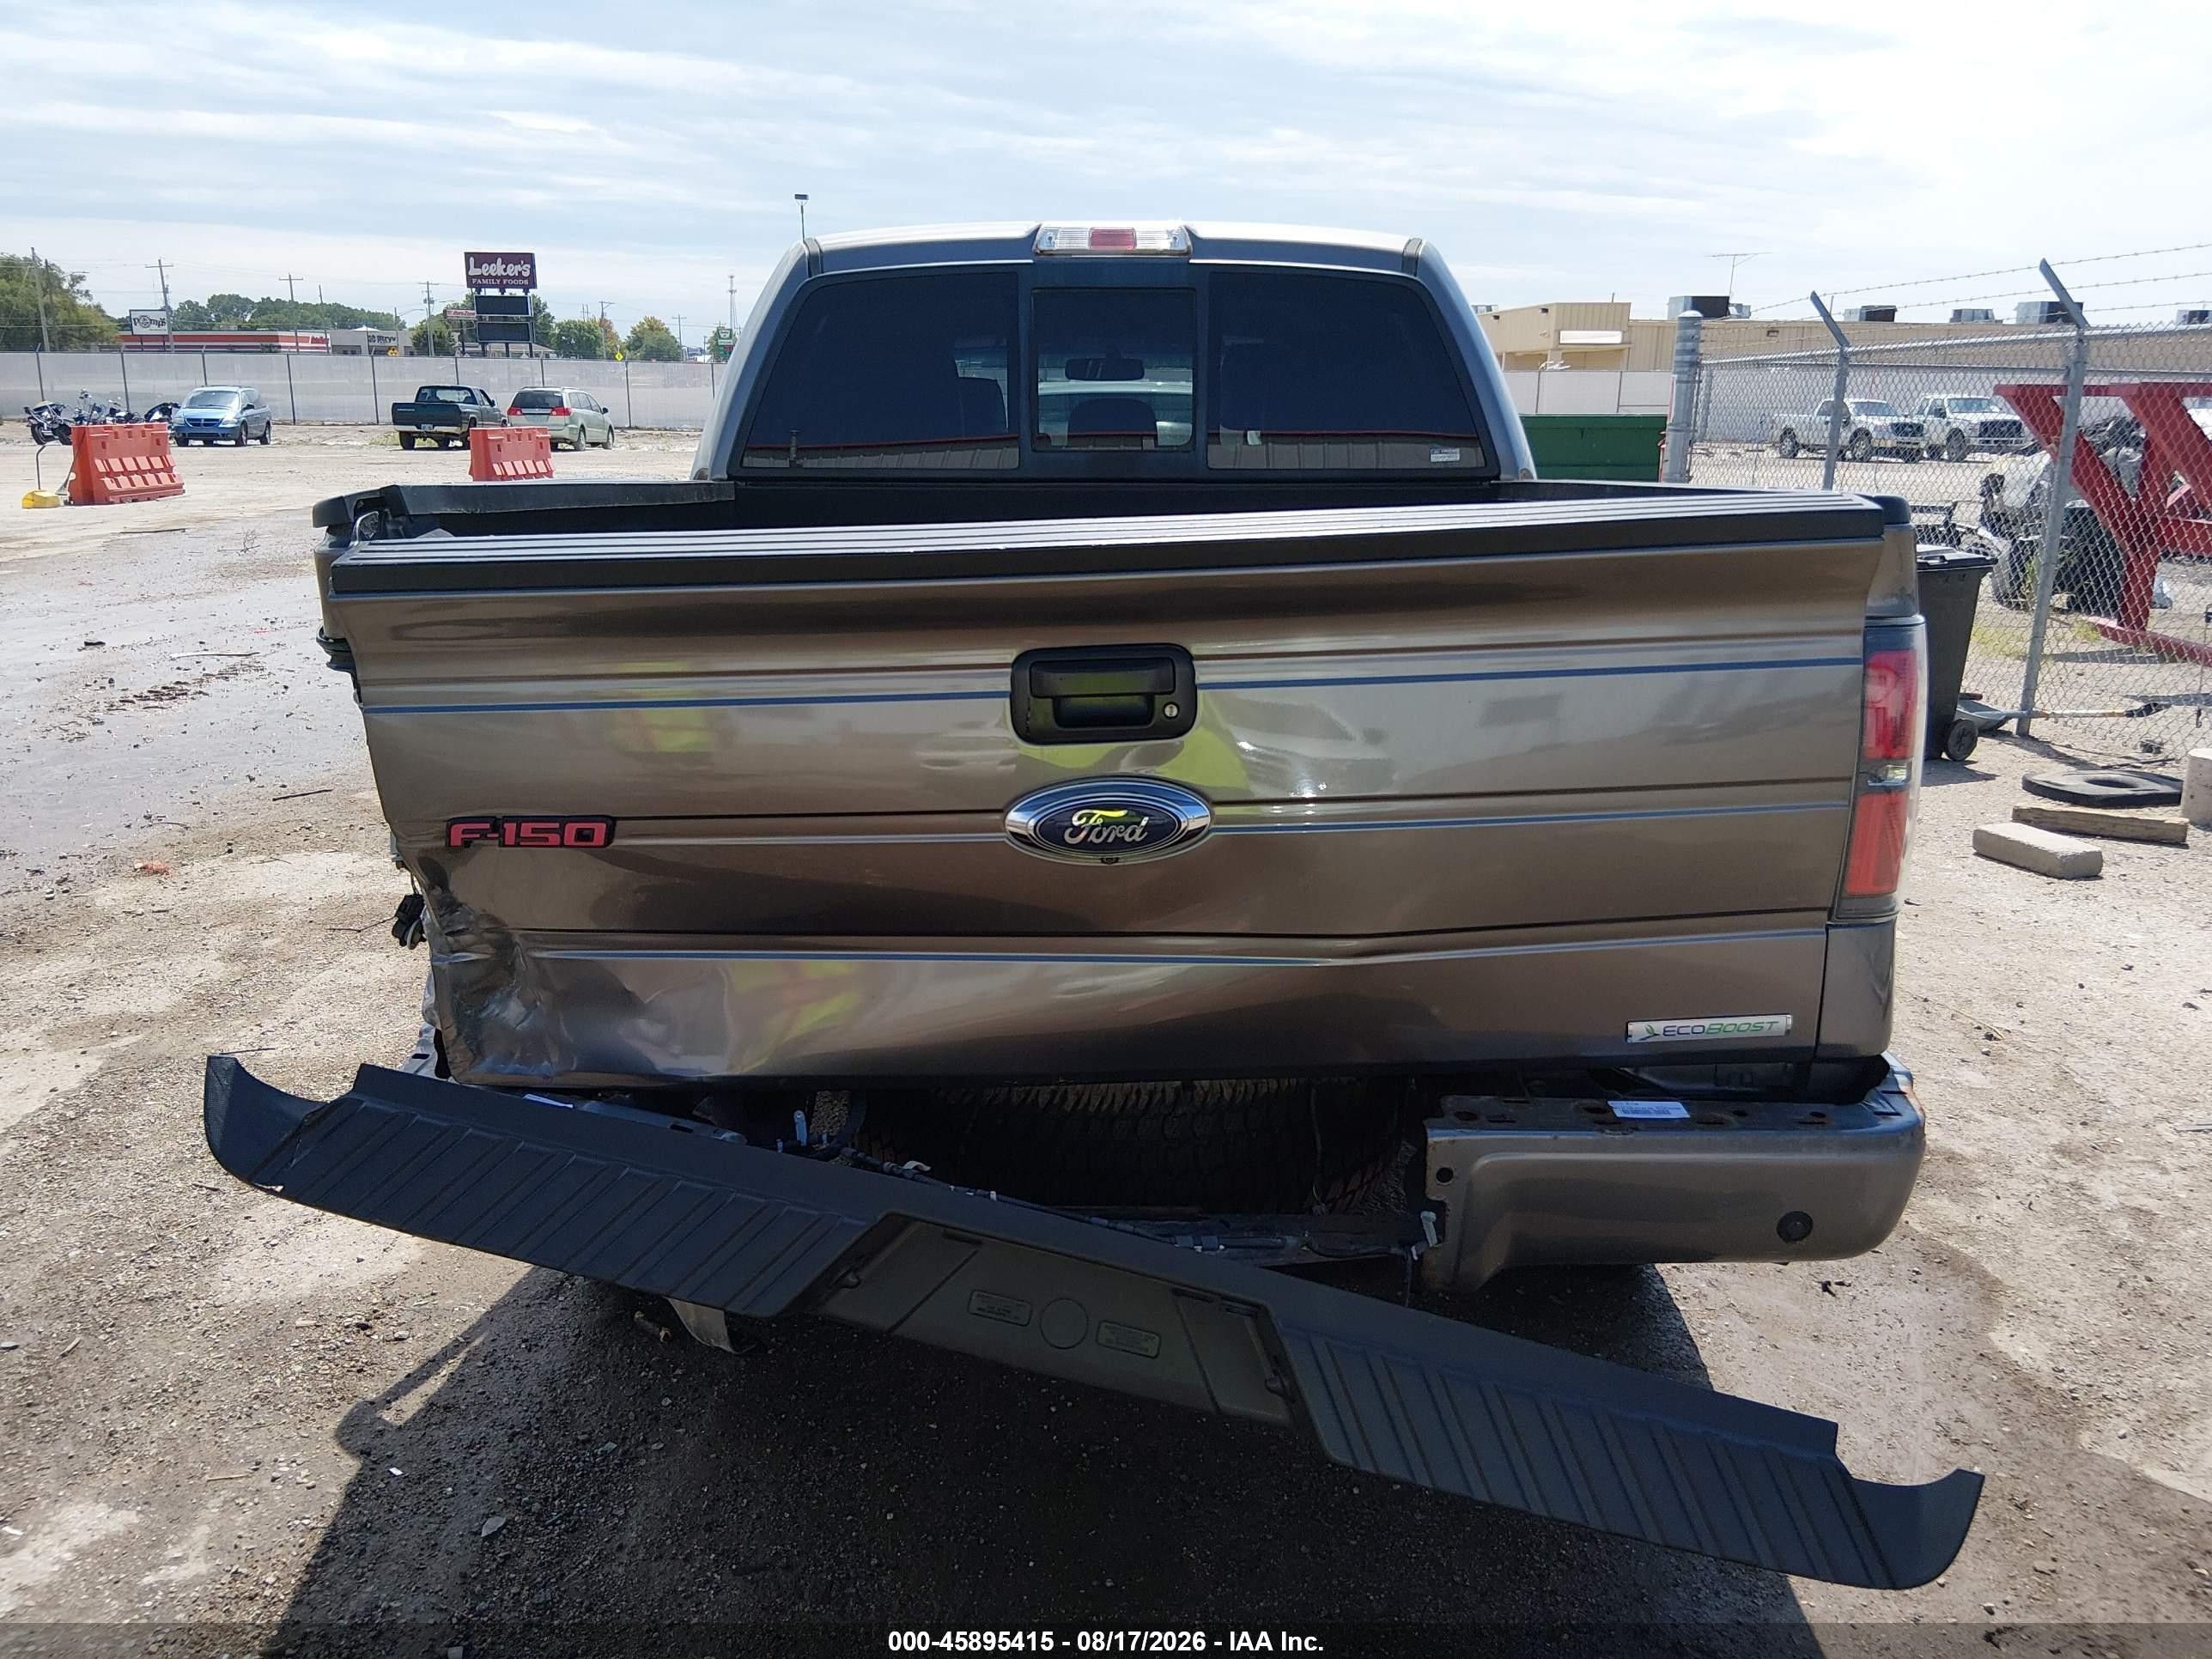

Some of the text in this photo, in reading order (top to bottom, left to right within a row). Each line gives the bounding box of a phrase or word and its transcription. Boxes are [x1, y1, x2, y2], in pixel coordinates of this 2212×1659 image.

[468, 256, 531, 277] Leeker's
[448, 820, 611, 848] F-150
[1064, 809, 1150, 845] Ford
[1662, 1020, 1780, 1037] ECOBOOST
